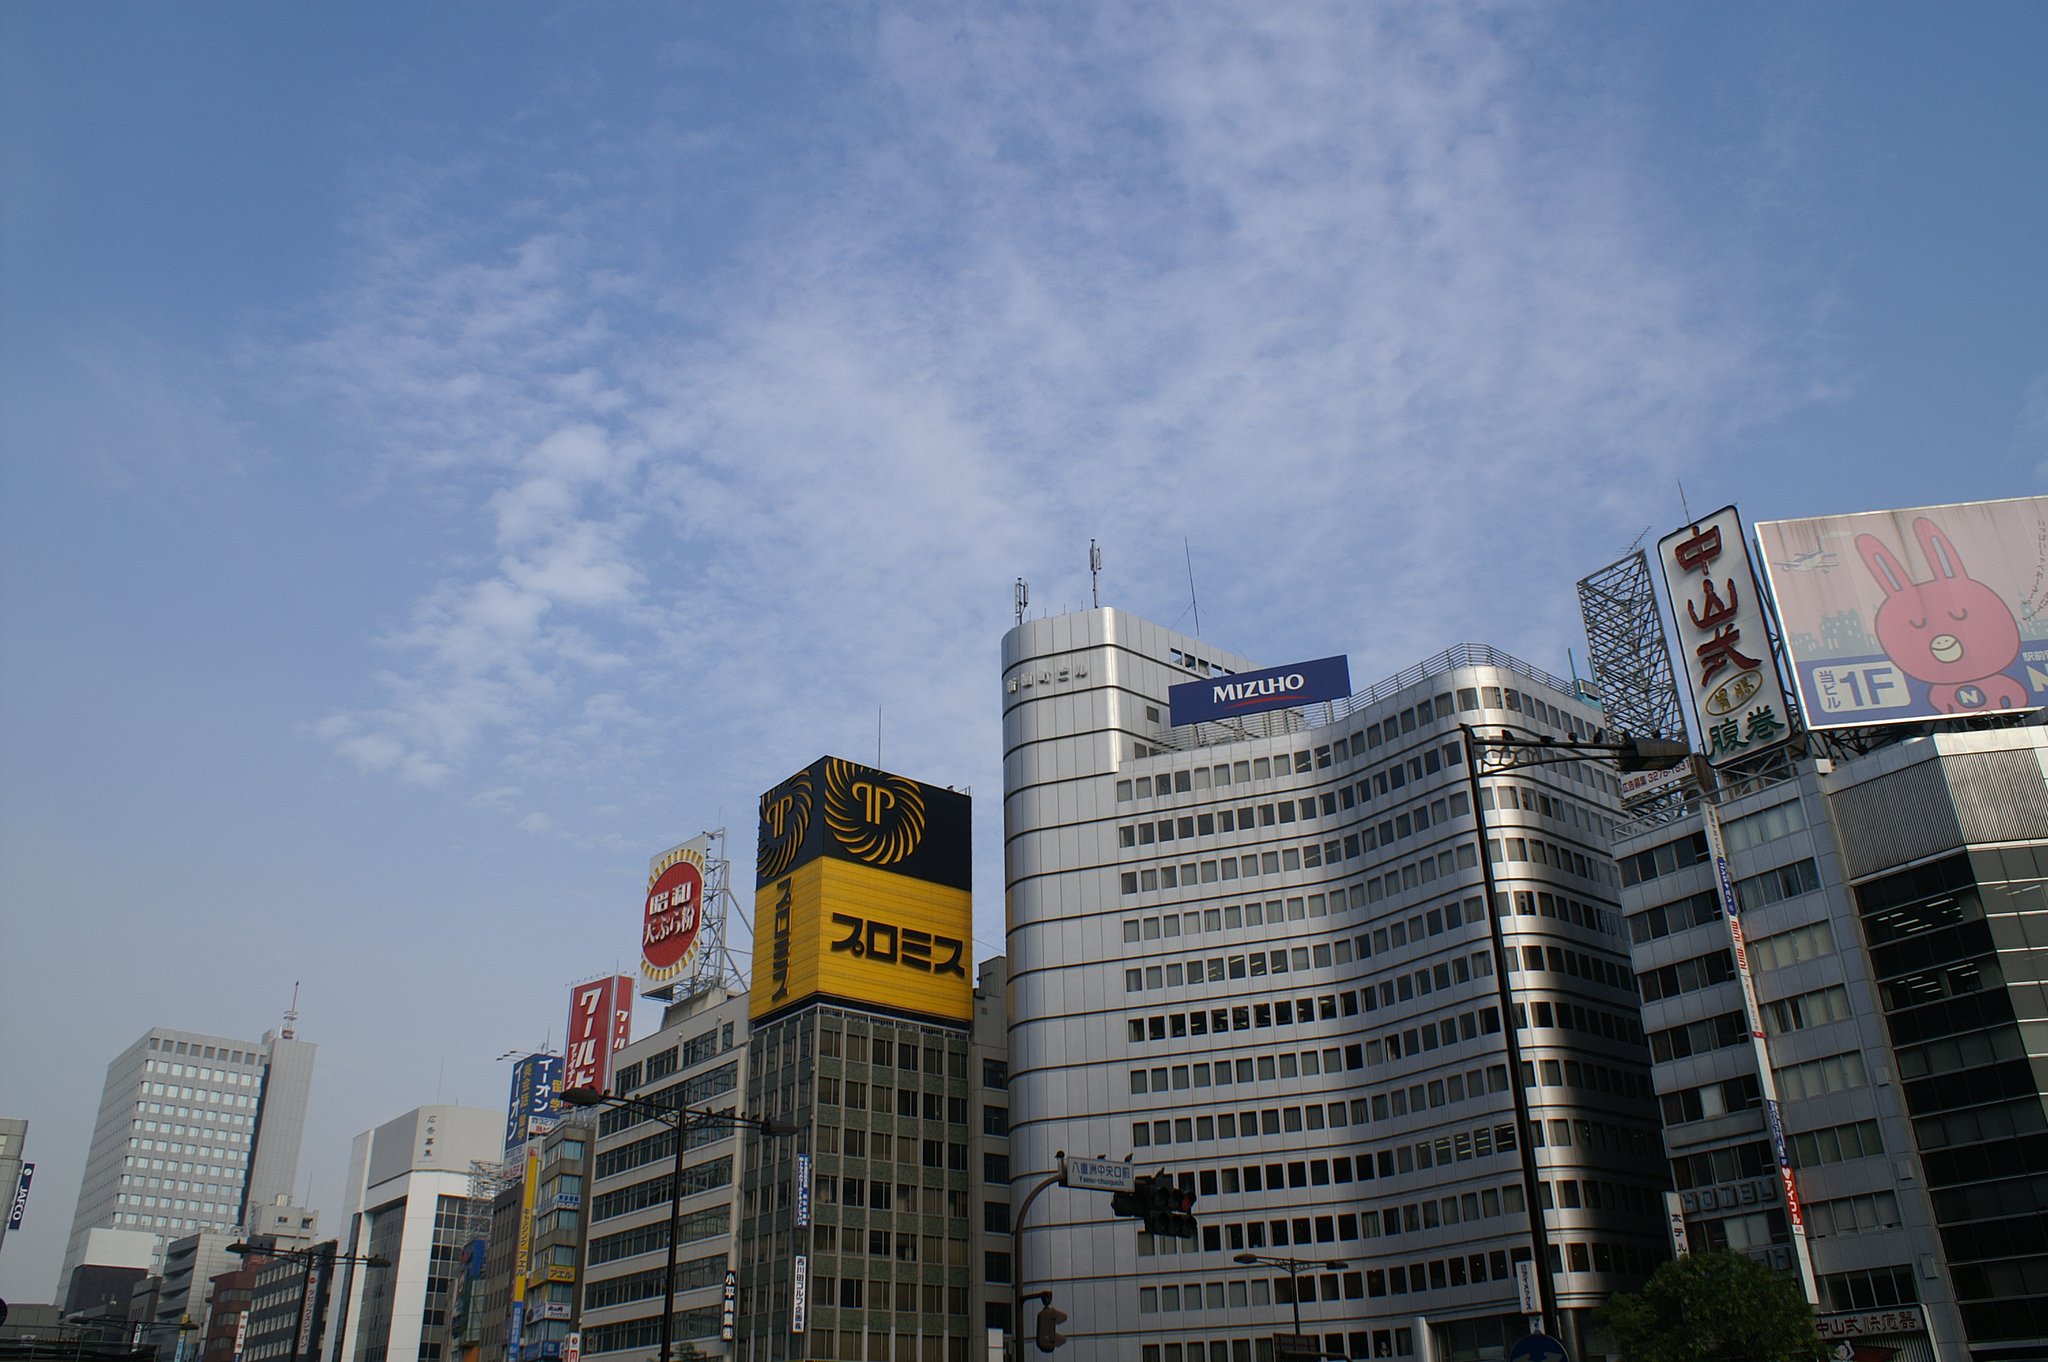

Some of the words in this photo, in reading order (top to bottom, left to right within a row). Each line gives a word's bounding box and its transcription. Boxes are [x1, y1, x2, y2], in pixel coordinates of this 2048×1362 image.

[1674, 525, 1763, 688] 中山式
[2022, 650, 2048, 662] 駅前
[1212, 673, 1305, 704] MIZUHO
[1818, 669, 1841, 709] 当ビル
[1839, 667, 1895, 707] 1F
[1706, 704, 1785, 758] 腹巻
[649, 881, 692, 915] 昭和
[643, 904, 695, 946] 天ぷら粉
[771, 876, 793, 1002] プロミス
[831, 911, 966, 978] プロミス
[574, 987, 603, 1089] ワールド
[508, 1062, 524, 1141] イーオン
[533, 1058, 554, 1113] イーオン
[13, 1185, 28, 1220] JAFCO
[1684, 1180, 1773, 1211] HOTEL
[1784, 1180, 1800, 1224] アイフル
[1671, 1214, 1687, 1252] ホテル
[549, 1269, 573, 1279] アエル
